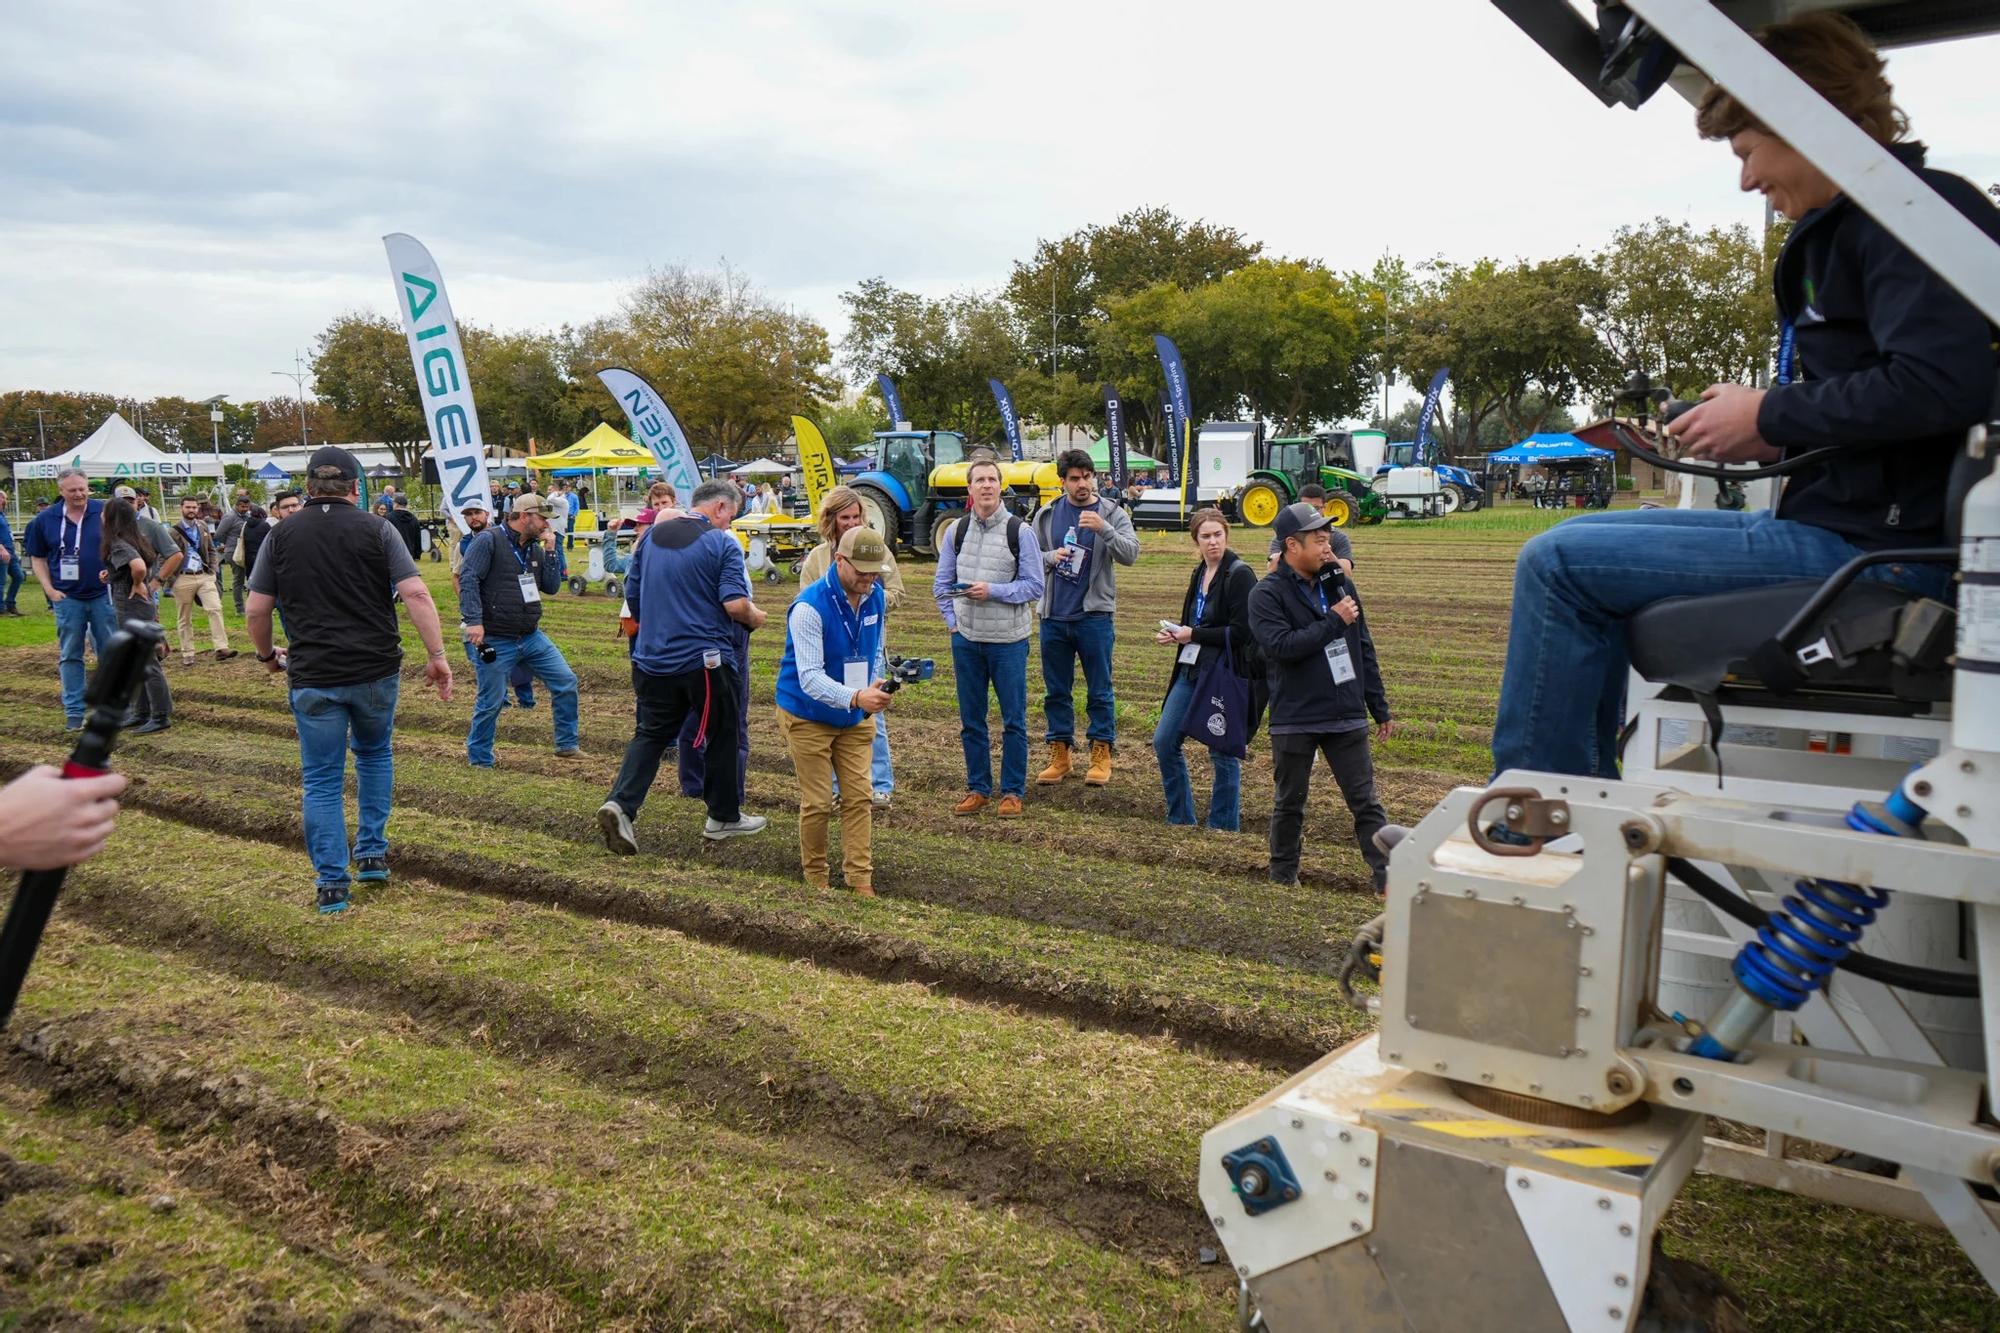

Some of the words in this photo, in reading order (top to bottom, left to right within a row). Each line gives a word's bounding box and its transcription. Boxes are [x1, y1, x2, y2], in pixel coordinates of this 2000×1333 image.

[402, 271, 483, 507] AIGEN
[624, 388, 691, 490] AIGEN
[1110, 411, 1119, 447] VERDANT
[1166, 414, 1177, 447] VERDANT
[28, 464, 61, 477] AIGEN
[114, 462, 192, 475] AIGEN
[1171, 447, 1180, 482] ROBOTICS
